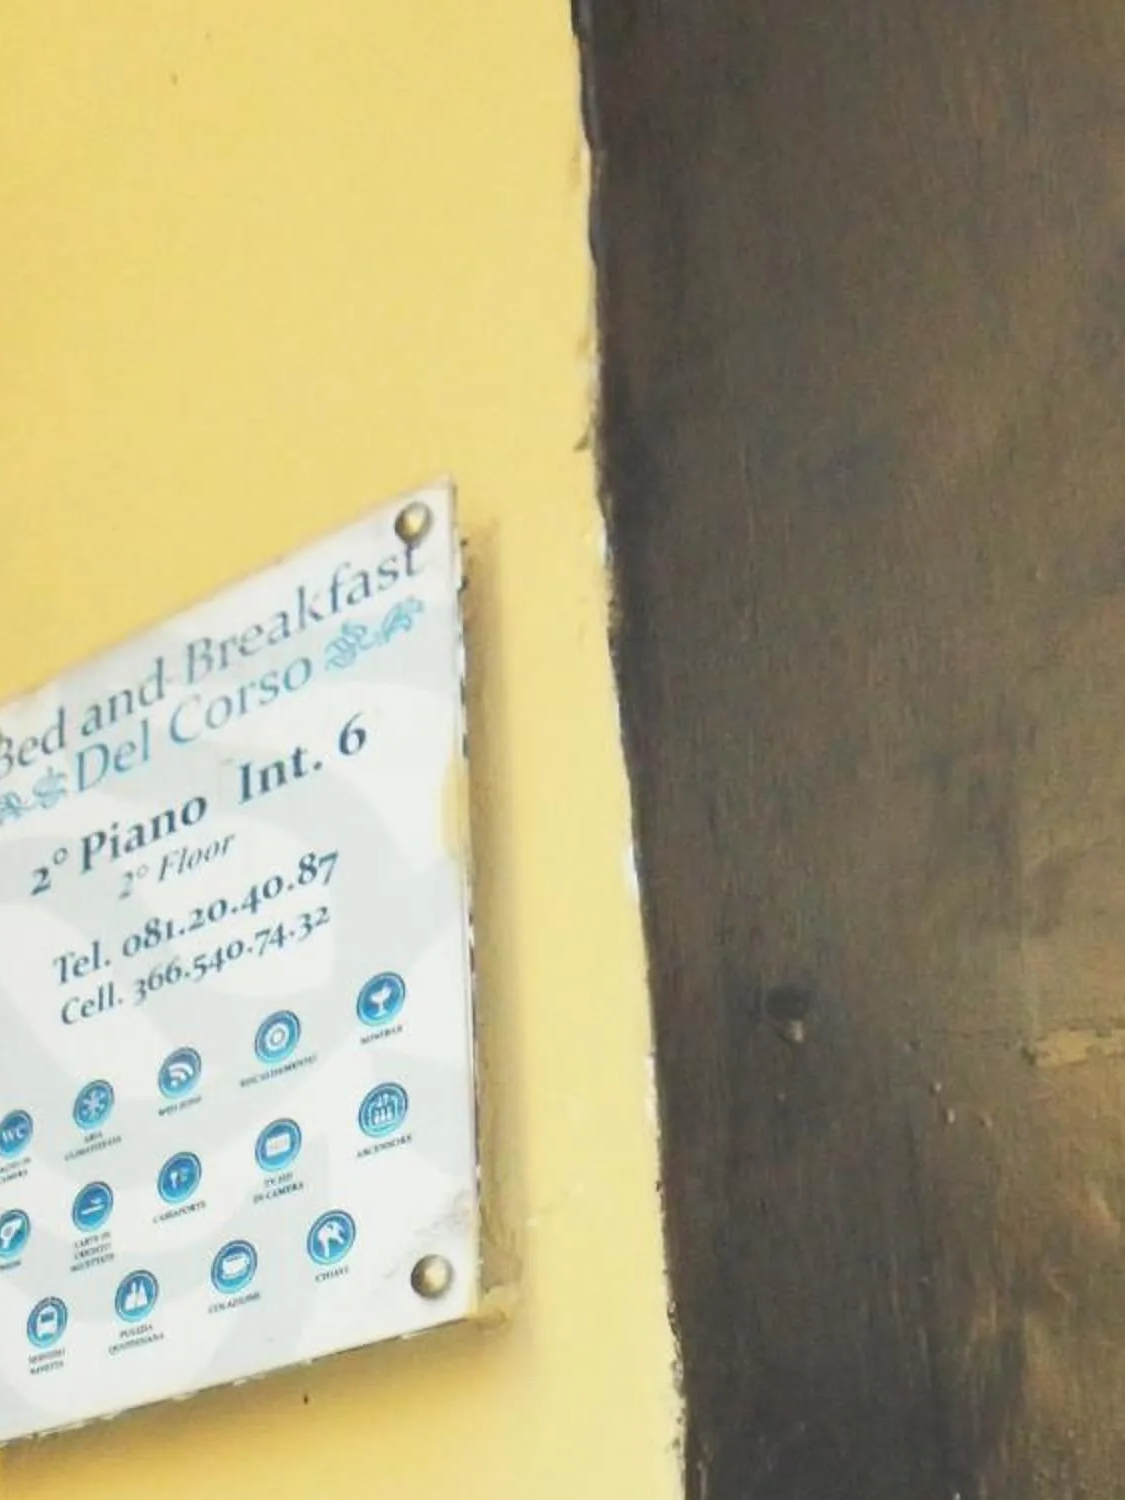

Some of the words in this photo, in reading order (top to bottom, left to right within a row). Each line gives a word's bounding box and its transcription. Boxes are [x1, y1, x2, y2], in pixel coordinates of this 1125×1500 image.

[80, 657, 166, 738] and
[183, 544, 422, 686] Breakfast
[75, 721, 152, 792] Del
[169, 656, 313, 746] Corso
[30, 846, 69, 896] 2°
[79, 794, 208, 874] Piano
[237, 745, 324, 805] Int.
[338, 712, 367, 757] 6
[157, 833, 236, 883] Floor
[53, 941, 112, 985] Tel.
[122, 850, 340, 958] 081.20.40.87
[61, 981, 125, 1026] Cell.
[133, 905, 331, 1009] 366.540.74.32
